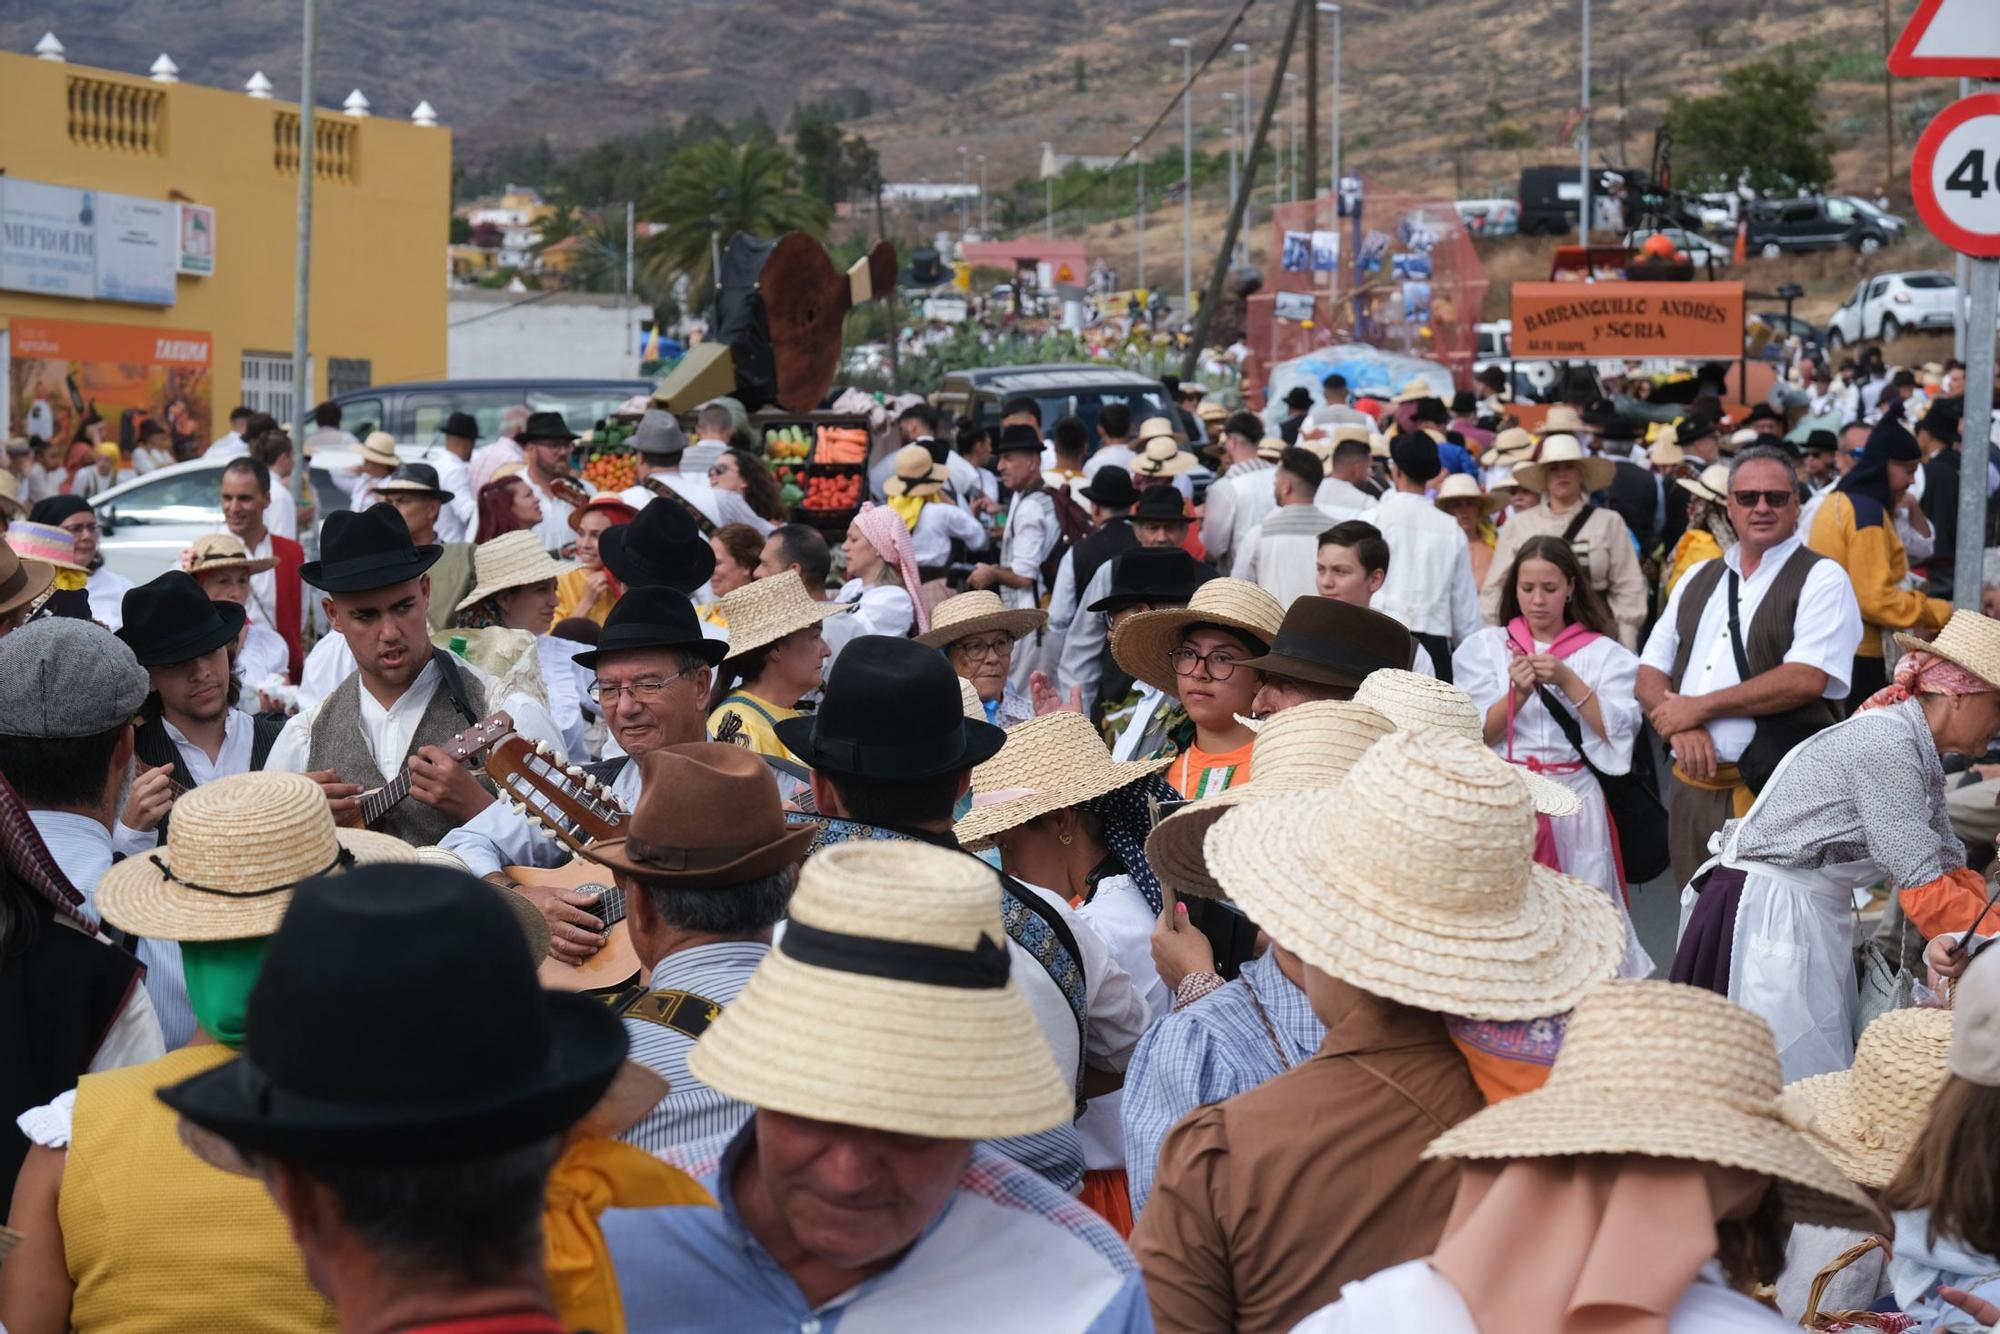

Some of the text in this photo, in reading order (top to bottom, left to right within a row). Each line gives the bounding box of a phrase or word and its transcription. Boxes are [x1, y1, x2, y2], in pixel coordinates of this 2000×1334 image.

[1945, 149, 2000, 199] 4
[1606, 321, 1667, 340] SORIA
[154, 338, 208, 362] TAKUMA
